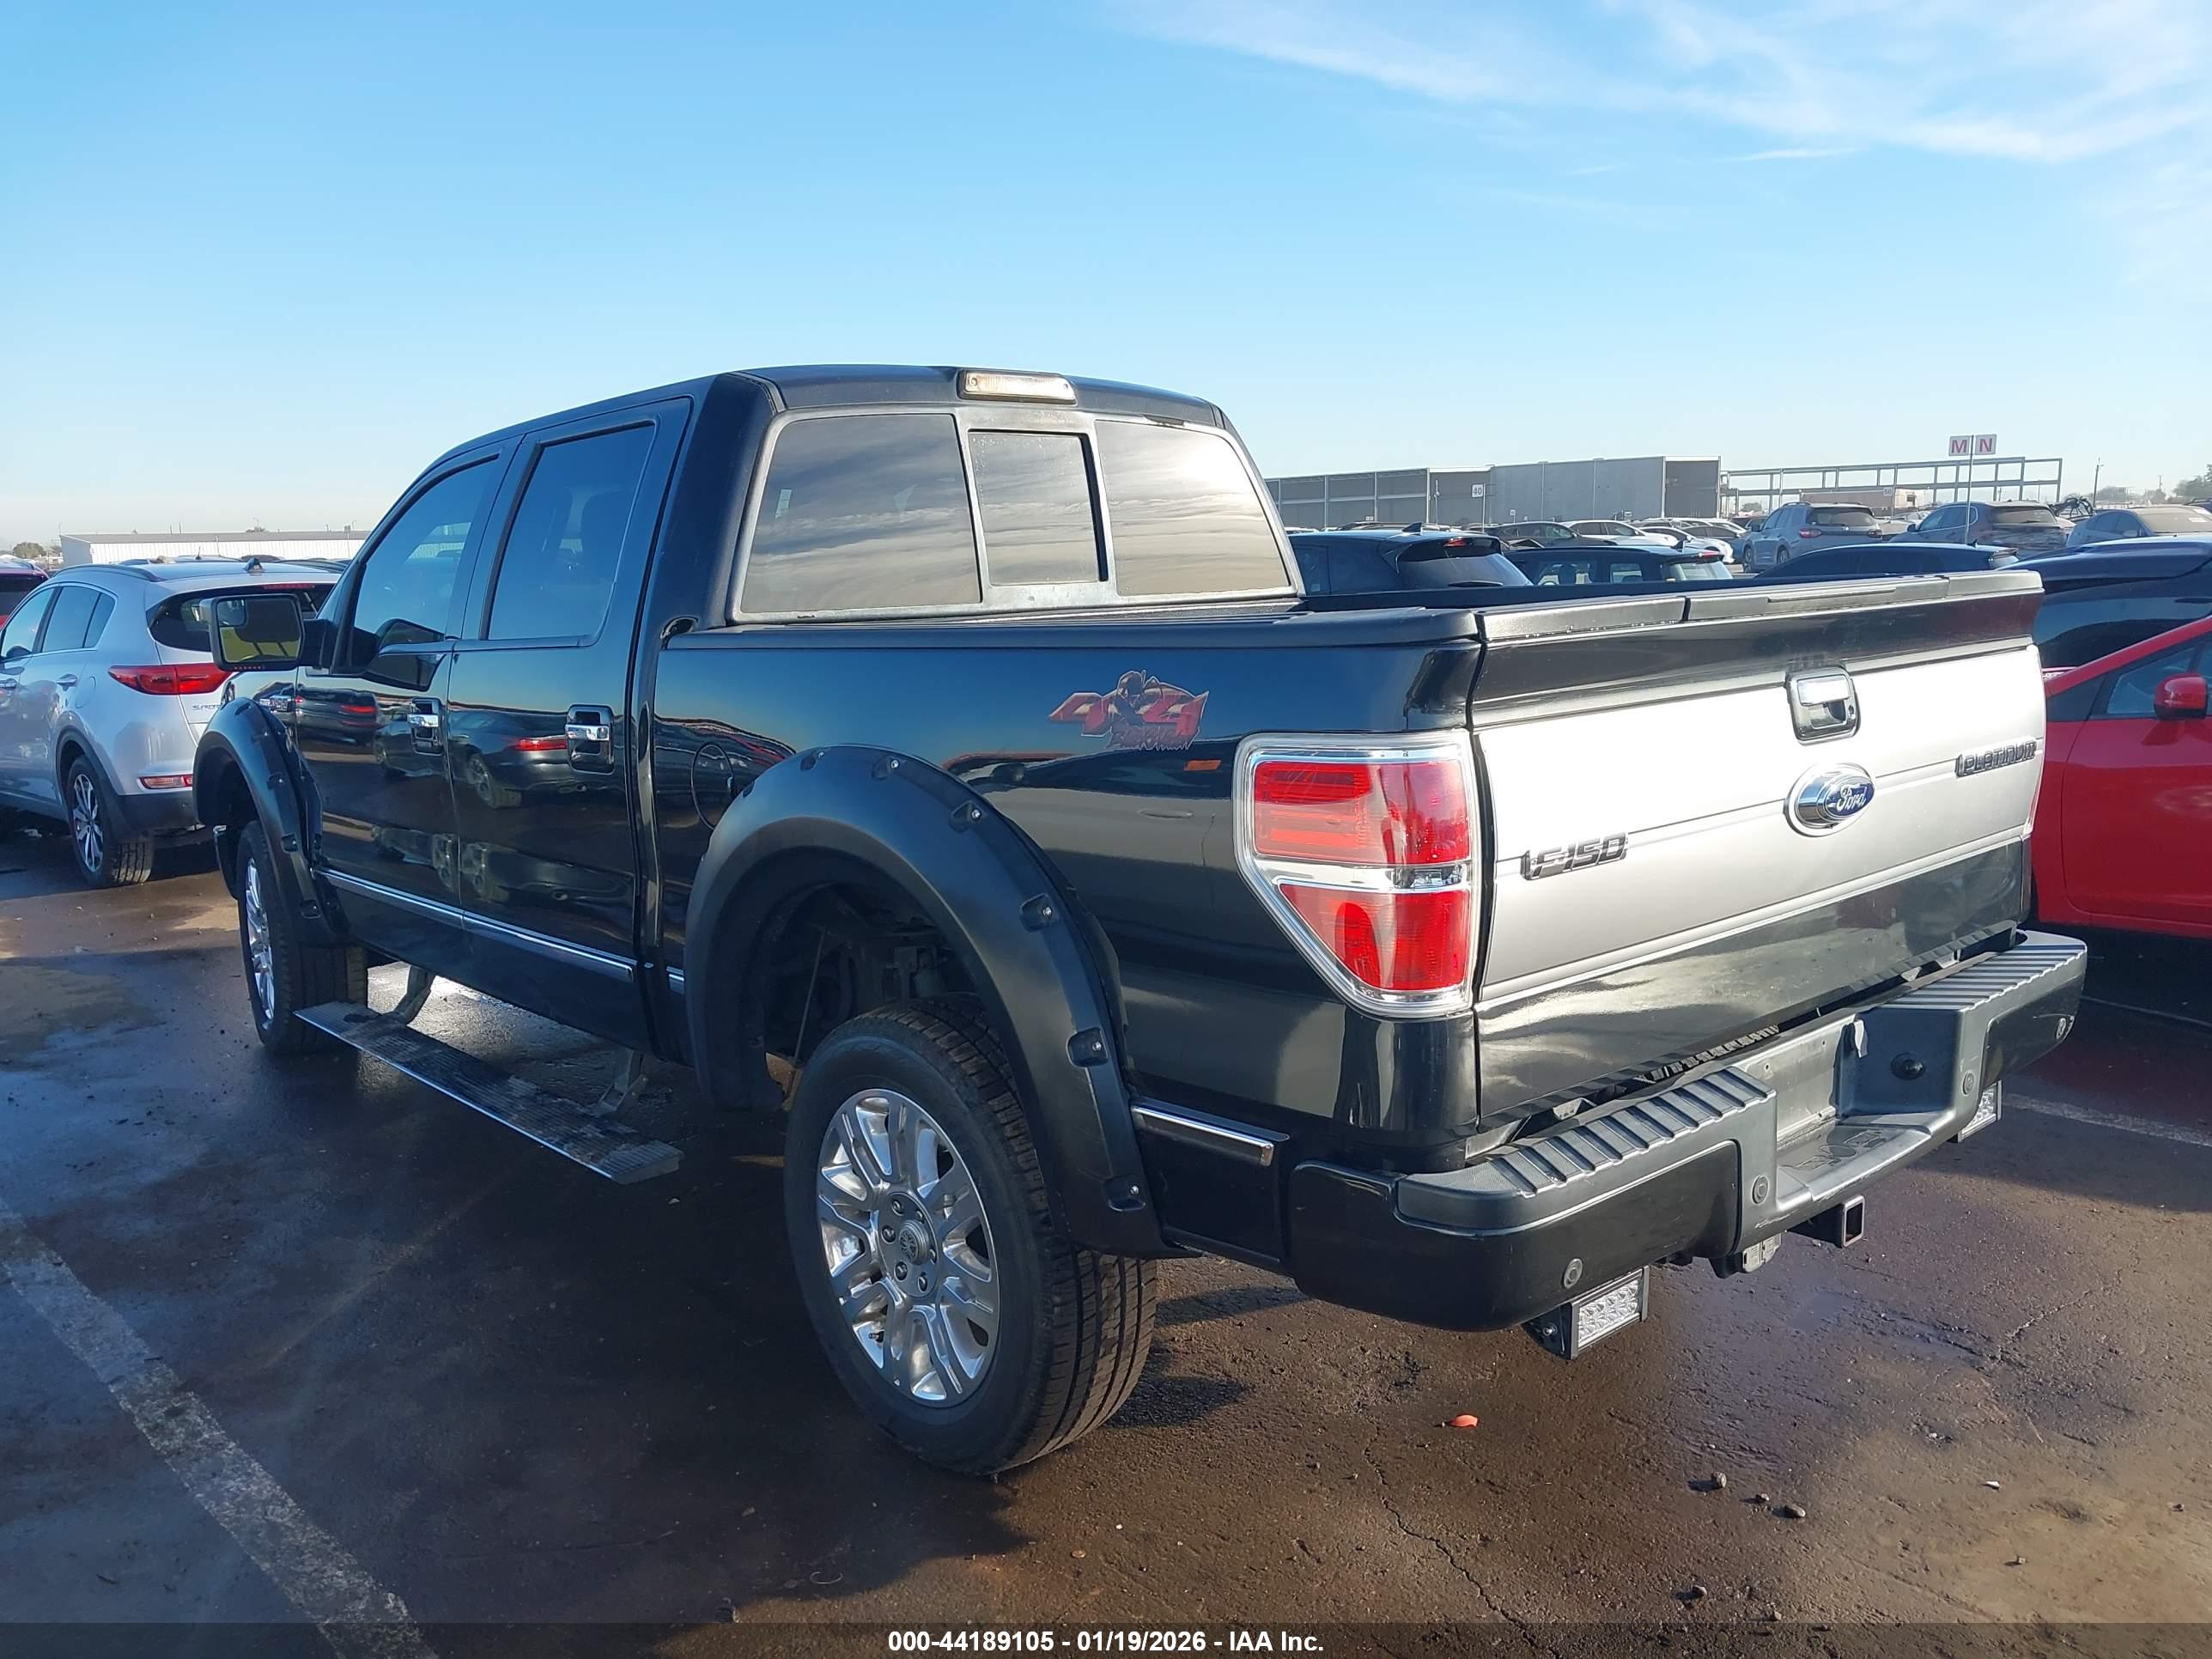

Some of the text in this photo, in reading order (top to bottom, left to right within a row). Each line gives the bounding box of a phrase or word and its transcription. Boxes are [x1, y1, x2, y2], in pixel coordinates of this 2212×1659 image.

[1951, 439, 1967, 454] M
[1978, 438, 1993, 453] N
[1473, 487, 1483, 495] 40
[1963, 739, 2036, 775] PLATINUM
[1836, 783, 1868, 811] Ford
